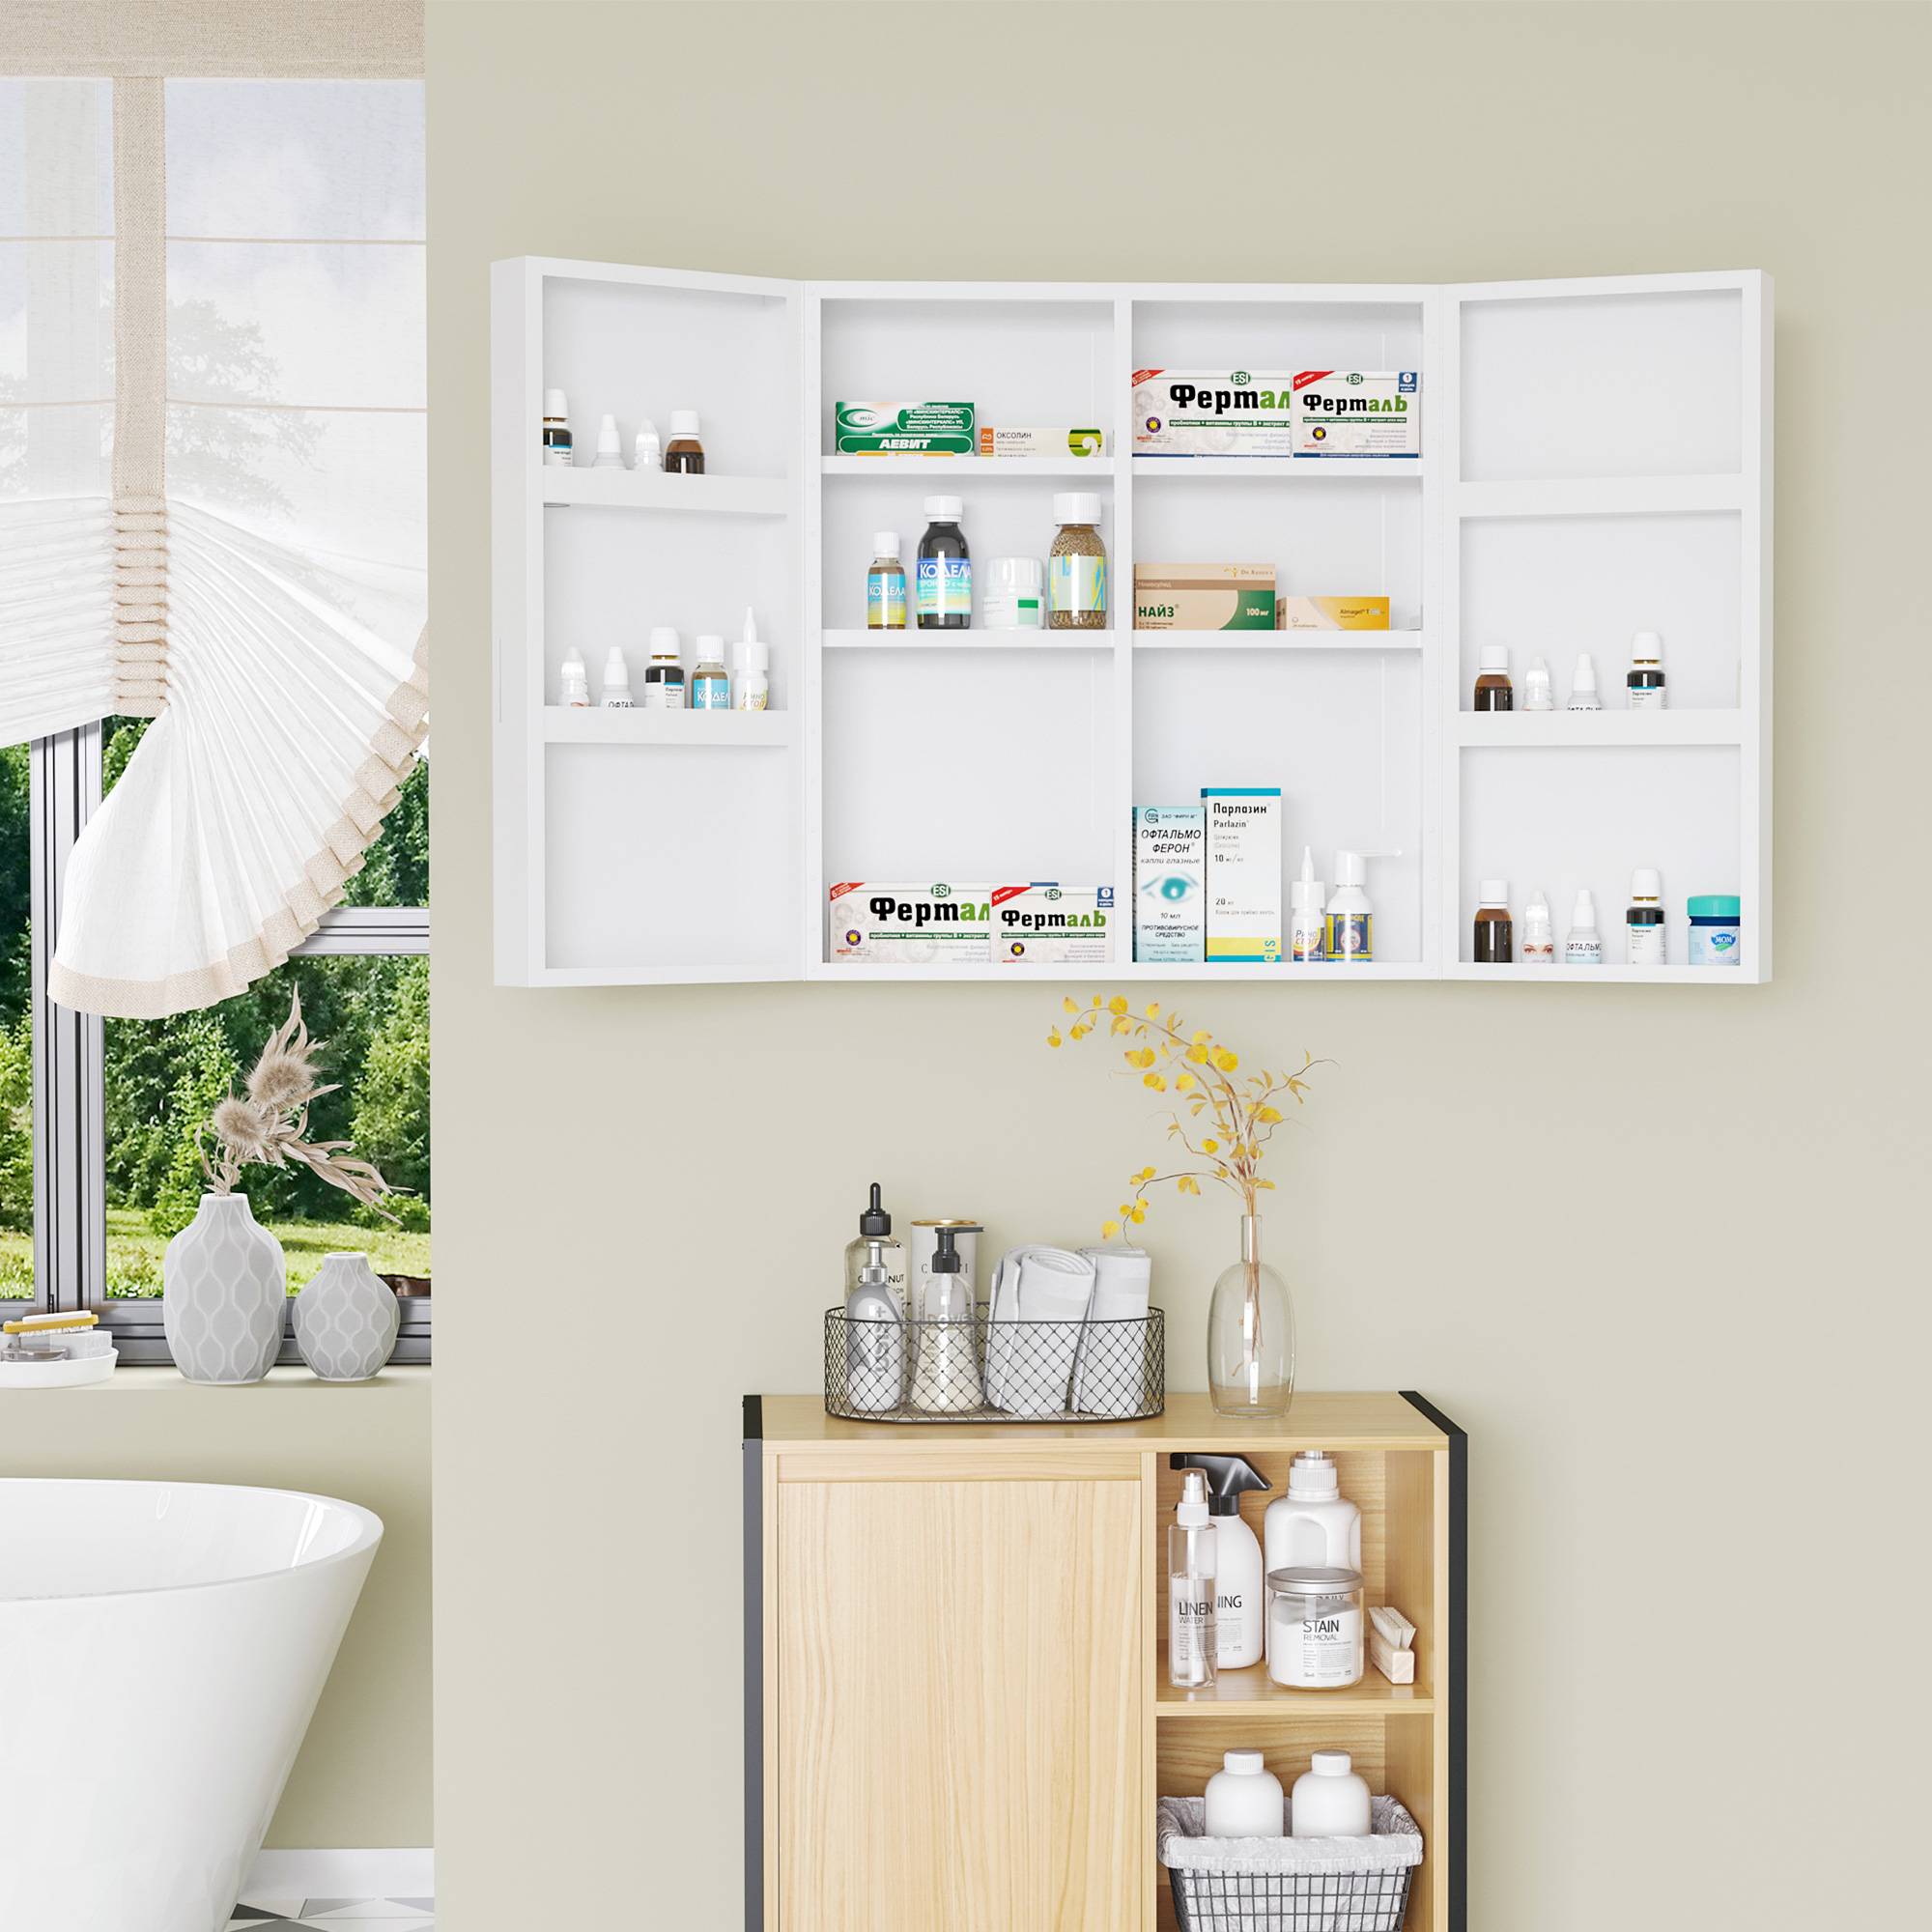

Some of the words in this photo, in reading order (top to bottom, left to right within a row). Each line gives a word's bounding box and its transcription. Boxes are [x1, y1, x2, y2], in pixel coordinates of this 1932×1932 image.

[1233, 373, 1250, 384] ESI
[1348, 374, 1362, 385] ESI
[1170, 384, 1291, 414] Фертал
[879, 439, 931, 449] АЕВИТ
[868, 586, 905, 596] КОЕЛА
[1213, 803, 1267, 816] Парлазин
[1213, 819, 1247, 828] Parlazin
[1141, 829, 1202, 838] ОФТАЛЬМО
[1152, 843, 1190, 853] ФЕРОН
[932, 885, 950, 896] ESI
[1046, 889, 1061, 900] ESI
[870, 897, 989, 926] Фертал
[858, 1274, 904, 1284] CNUT
[1179, 1602, 1213, 1615] LINEN
[1302, 1620, 1340, 1633] STAIN
